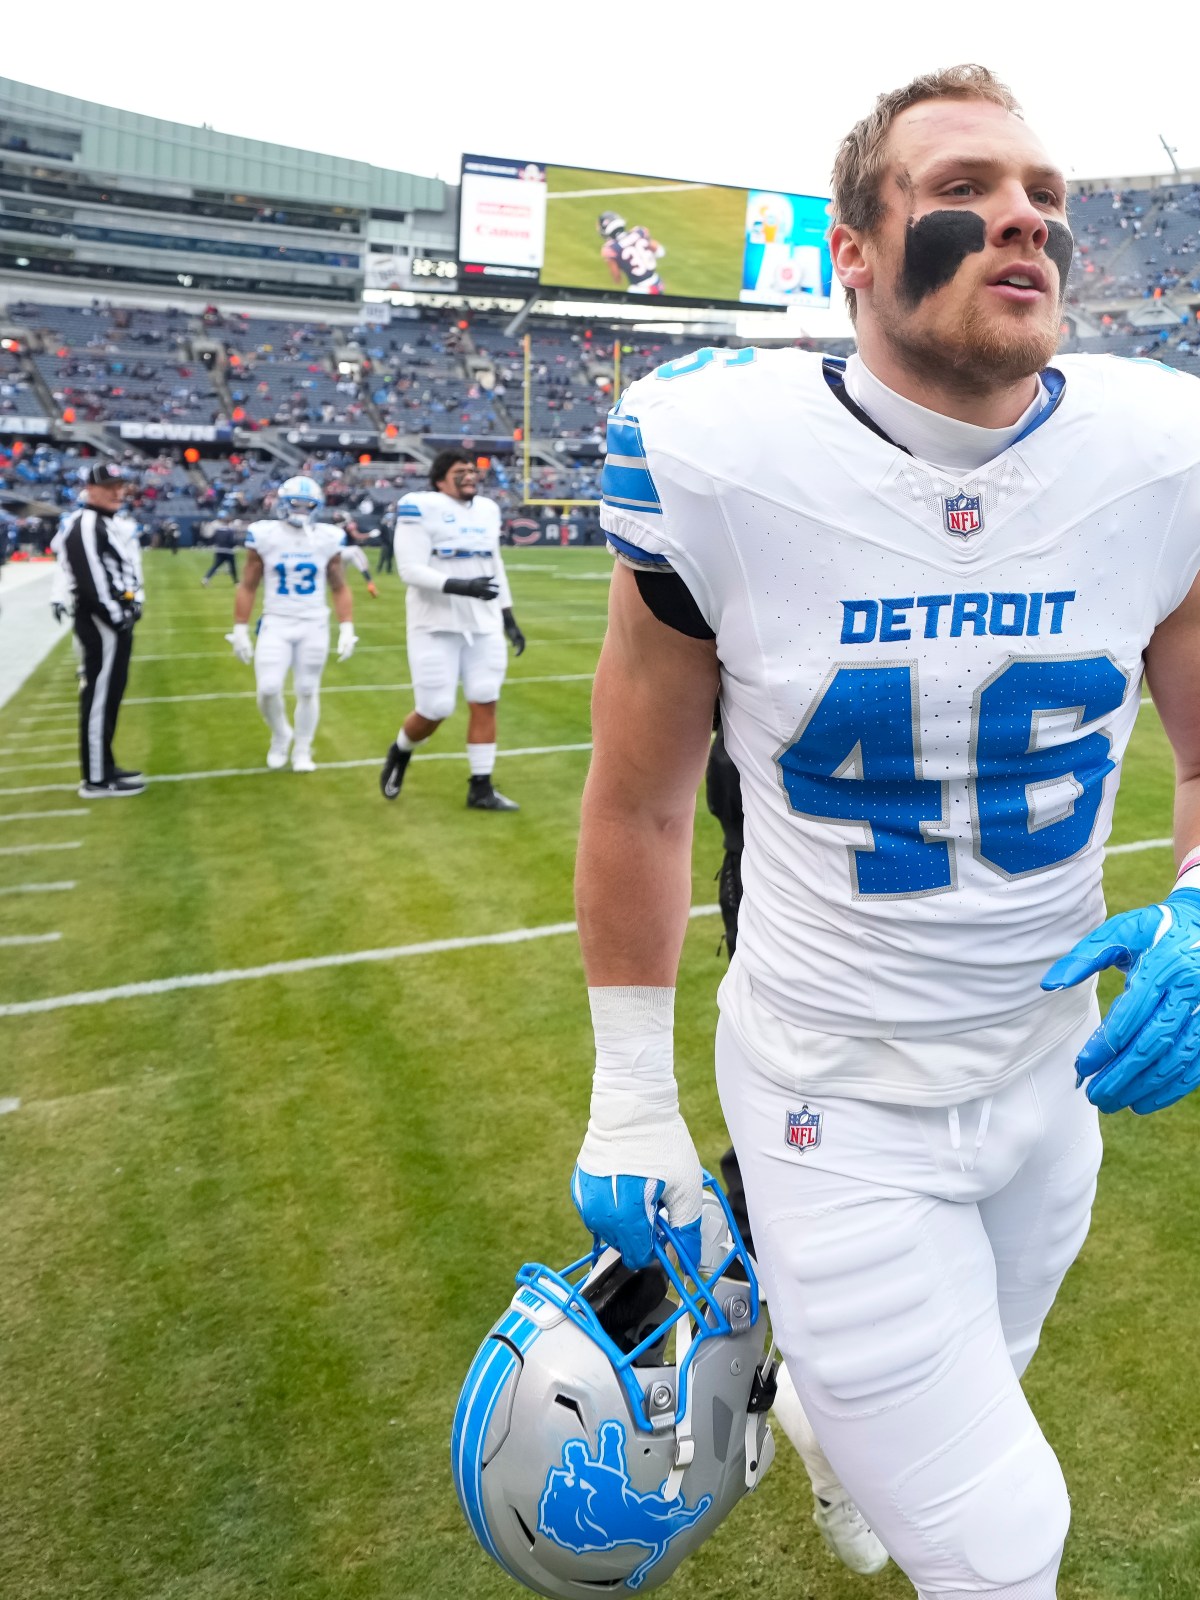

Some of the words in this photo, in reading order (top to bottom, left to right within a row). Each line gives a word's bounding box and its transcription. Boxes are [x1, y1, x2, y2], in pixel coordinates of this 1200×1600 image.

[120, 422, 216, 441] DOWN
[950, 511, 978, 531] NFL
[273, 563, 317, 595] 13
[839, 590, 1076, 644] DETROIT
[771, 648, 1131, 902] 46
[790, 1127, 815, 1146] NFL
